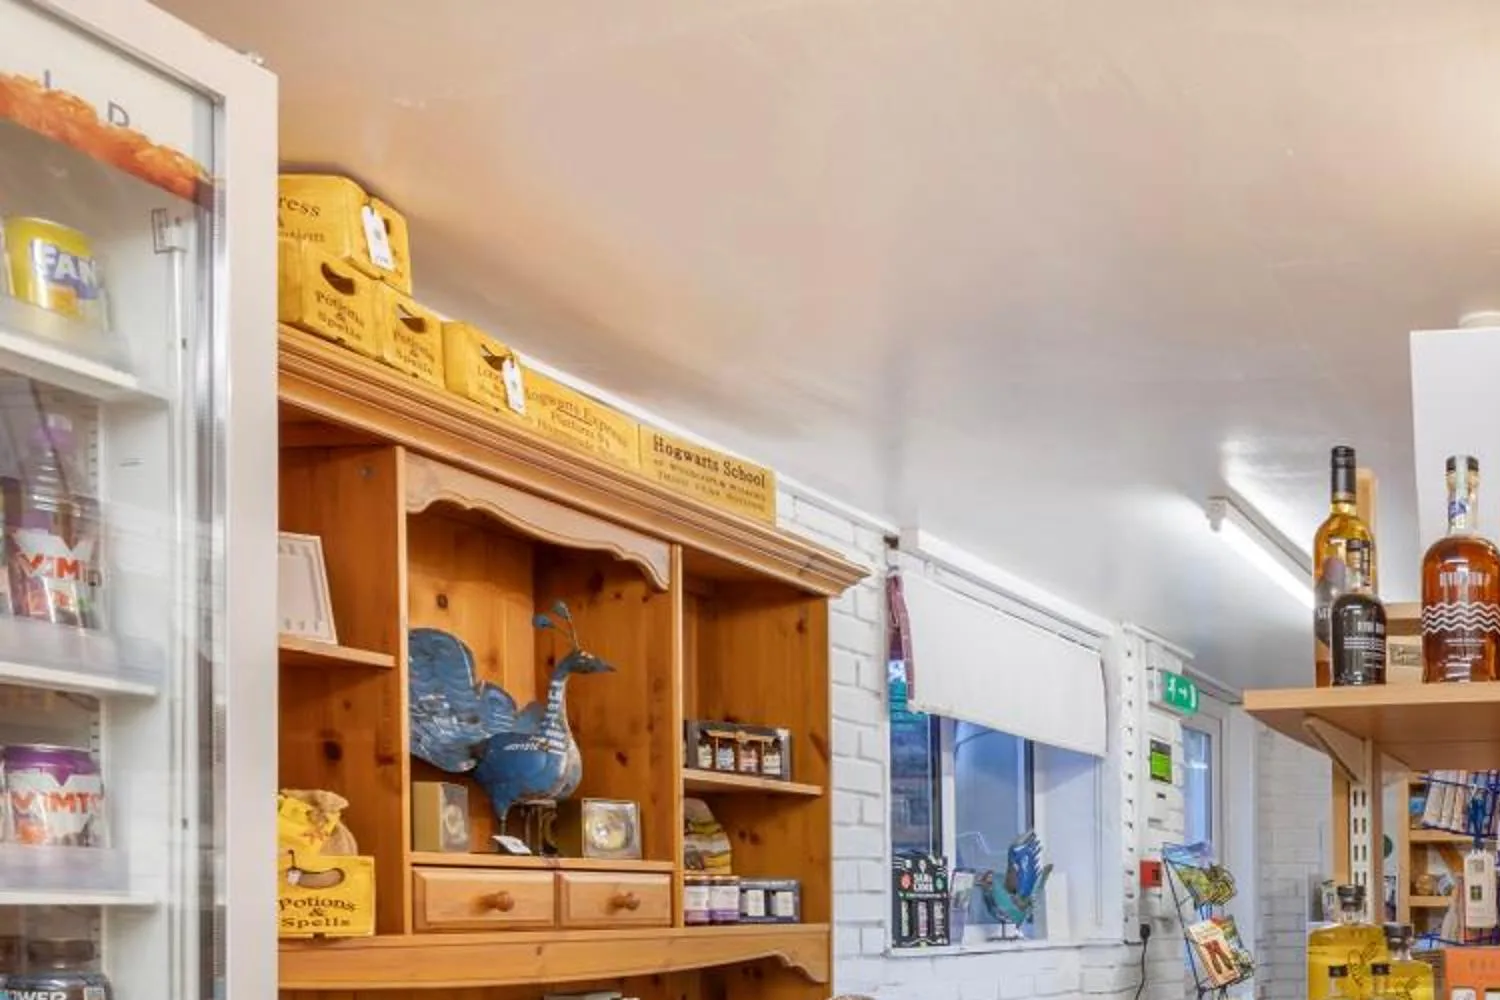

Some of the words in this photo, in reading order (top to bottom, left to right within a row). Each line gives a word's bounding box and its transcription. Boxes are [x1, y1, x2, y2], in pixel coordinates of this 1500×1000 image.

[278, 195, 321, 217] ress
[652, 433, 721, 474] Hogwarts
[722, 460, 766, 487] School
